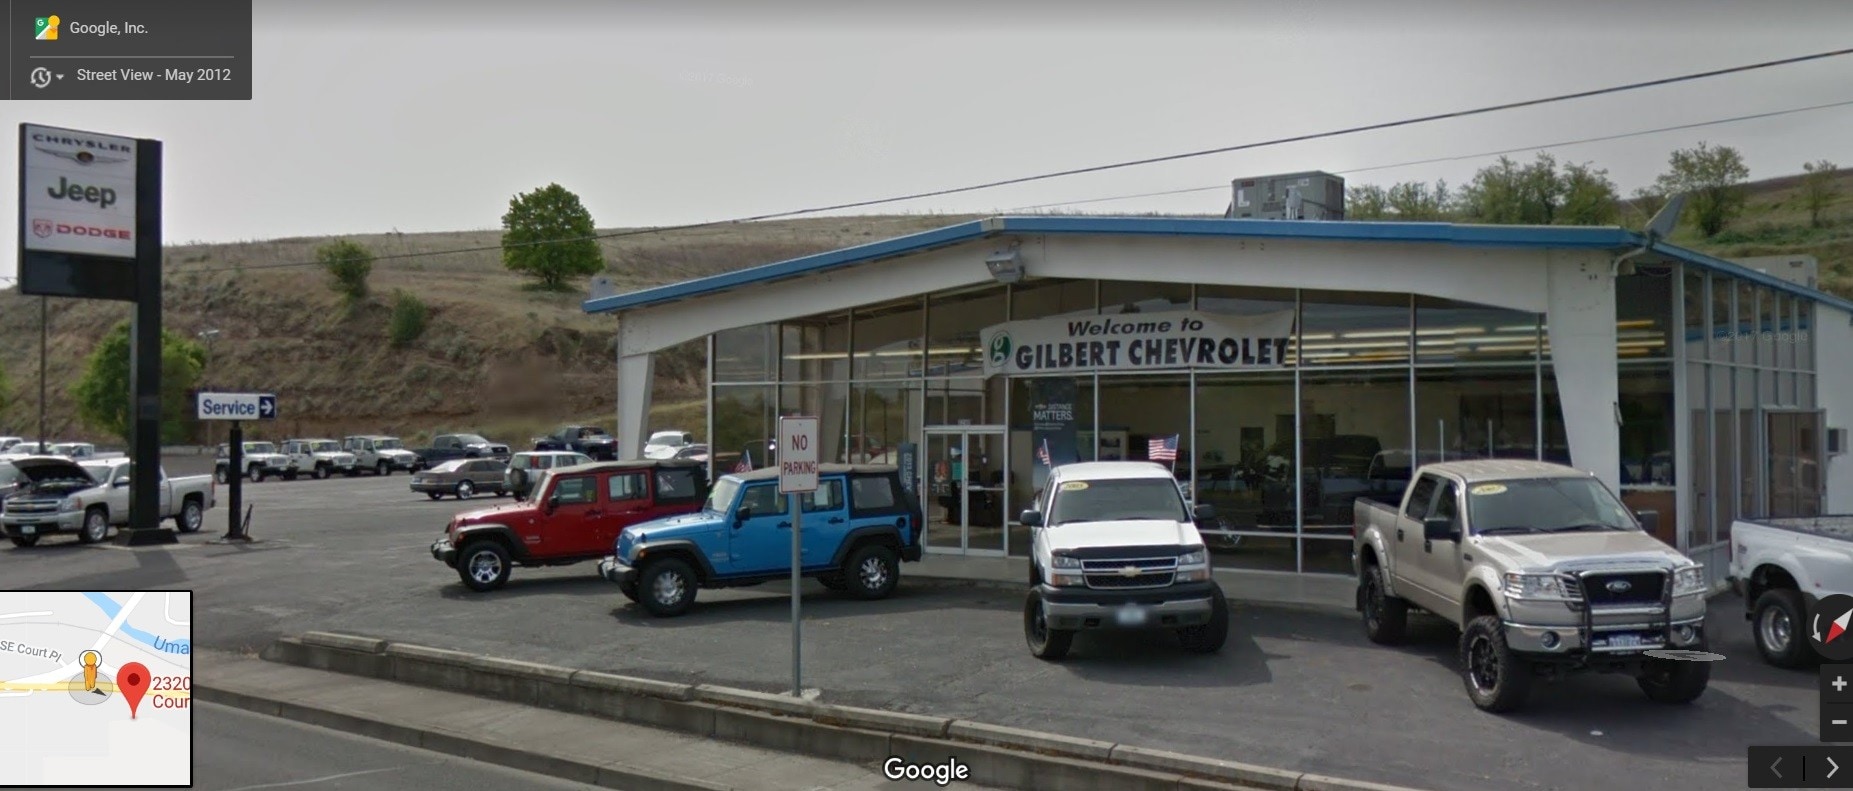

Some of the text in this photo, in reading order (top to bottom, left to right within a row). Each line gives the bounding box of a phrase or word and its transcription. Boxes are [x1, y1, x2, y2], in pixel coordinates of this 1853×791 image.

[32, 133, 131, 153] CHRYSLER
[47, 176, 117, 209] Jeep
[56, 224, 131, 240] DODGE
[1068, 317, 1204, 337] Welcome to
[1015, 336, 1290, 370] GILBERT CHEVROLET
[202, 399, 256, 415] Service
[791, 434, 808, 451] NO
[783, 461, 816, 475] PARKING
